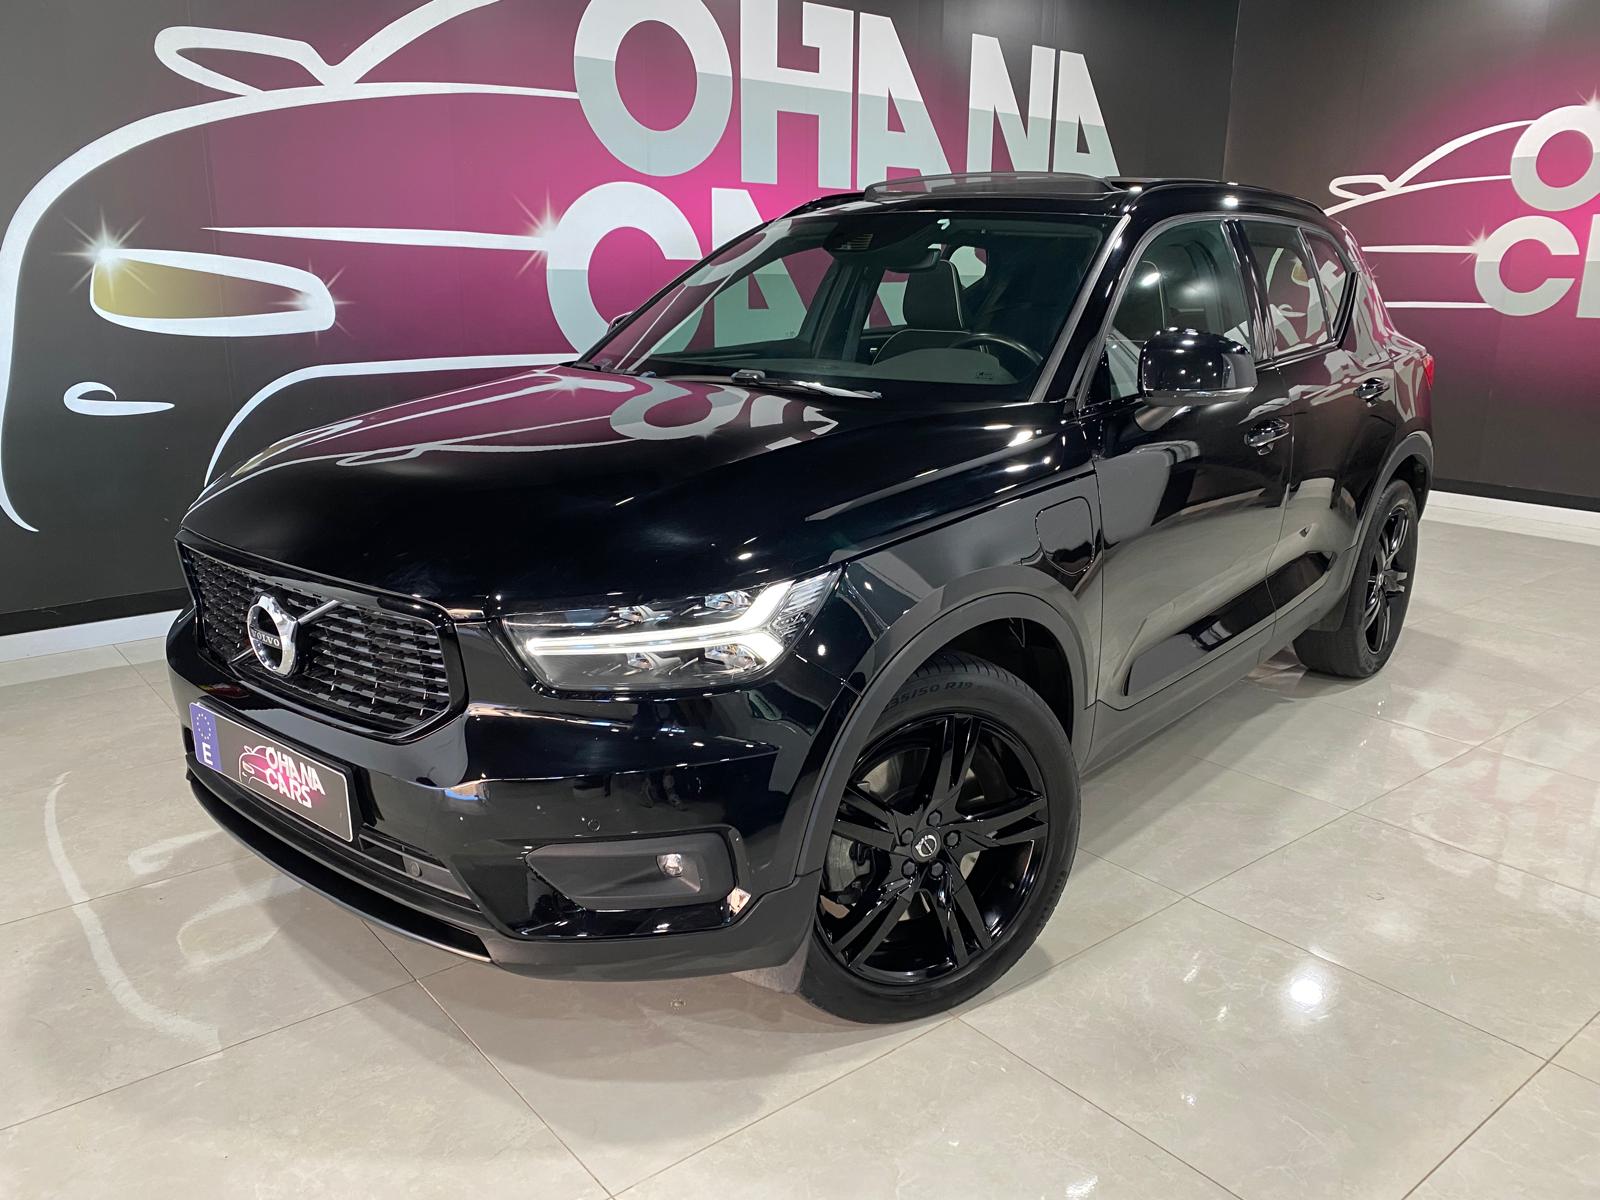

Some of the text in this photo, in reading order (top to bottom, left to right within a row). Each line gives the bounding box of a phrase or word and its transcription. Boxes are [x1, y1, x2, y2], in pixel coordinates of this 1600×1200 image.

[573, 0, 1120, 191] OHANA
[251, 629, 280, 646] VOLVO
[887, 684, 940, 711] 35/50
[202, 742, 213, 765] E
[265, 747, 325, 795] OHANA
[265, 768, 312, 808] CARS
